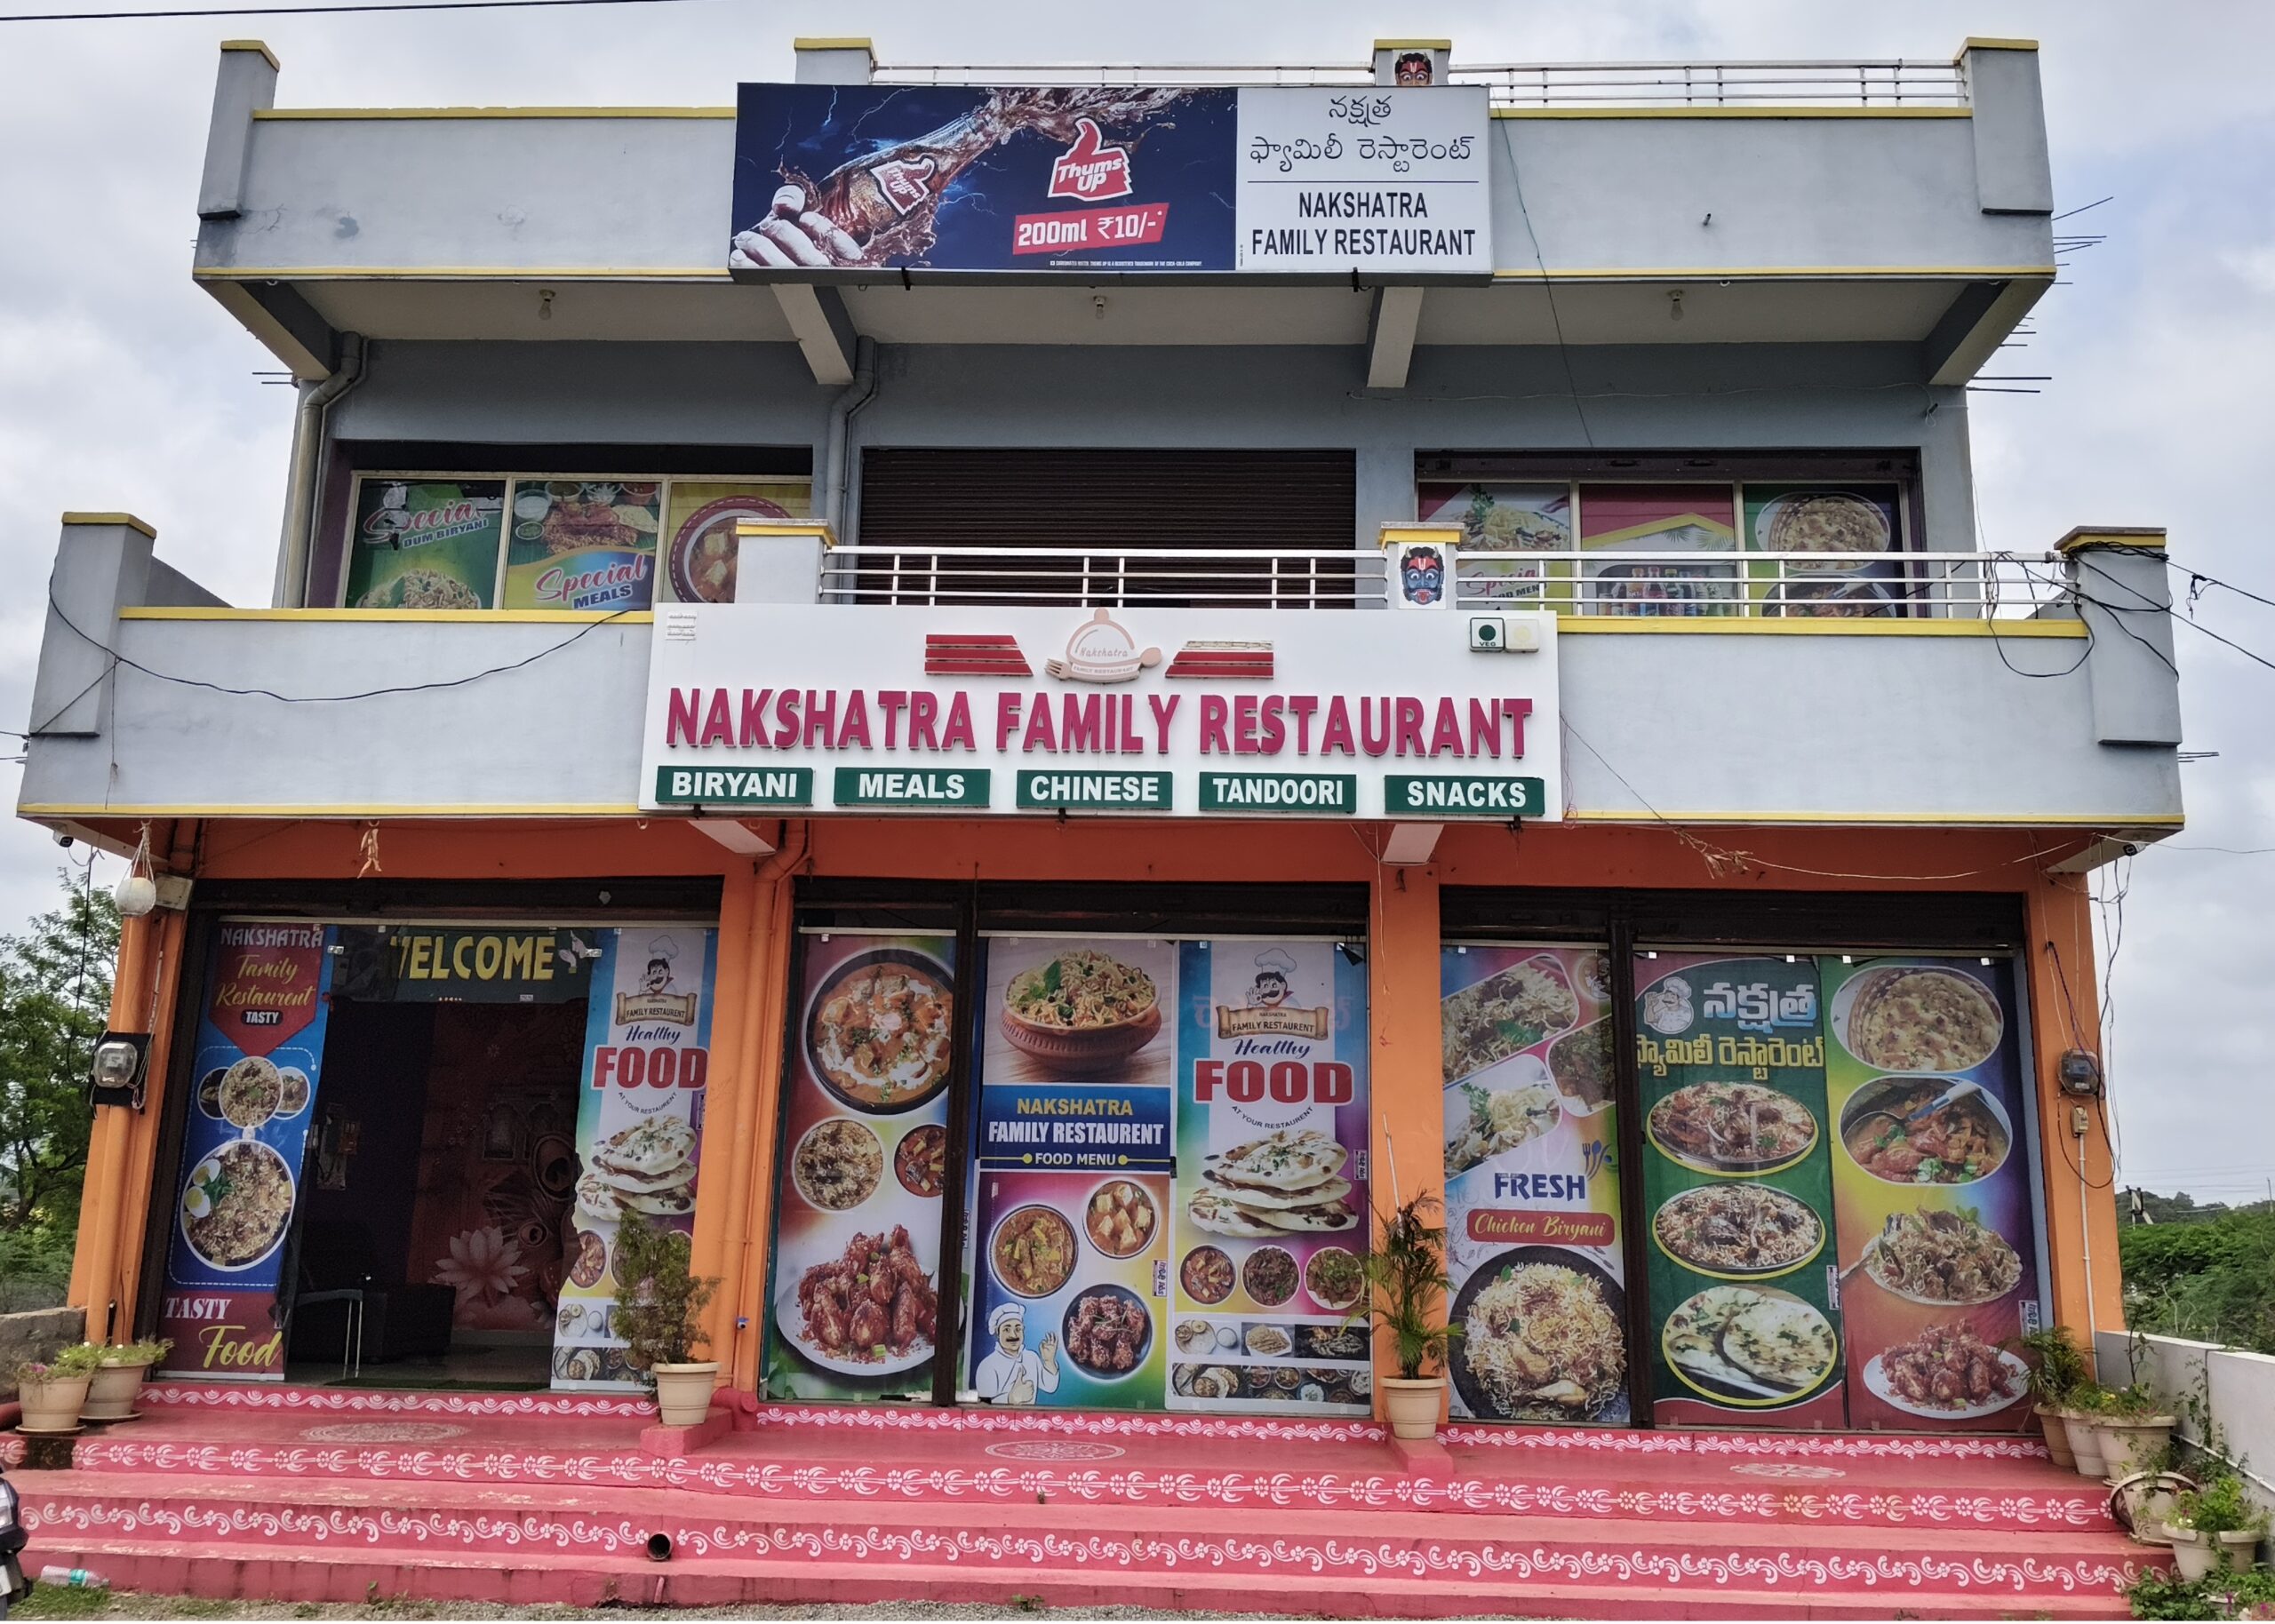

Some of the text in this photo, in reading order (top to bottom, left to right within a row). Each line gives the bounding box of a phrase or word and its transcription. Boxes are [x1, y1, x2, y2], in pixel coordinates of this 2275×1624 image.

[1329, 95, 1392, 128] నక్షత్ర
[1249, 132, 1475, 172] ఫ్యామిలీ రెస్టారెంట్
[1058, 157, 1122, 184] Thums
[1077, 172, 1107, 193] UP
[1298, 192, 1428, 218] NAKSHATRA
[1018, 219, 1088, 247] 200ml
[1251, 228, 1476, 255] FAMILY RESTAURANT
[403, 520, 488, 548] DUM BIRYANI
[535, 554, 644, 602] Special
[573, 585, 633, 609] MEALS
[1079, 647, 1128, 657] Nakshatra
[666, 688, 1533, 760] NAKSHATRA FAMILY RESTAURANT
[671, 771, 798, 798] BIRYANI
[858, 773, 965, 800] MEALS
[1030, 776, 1159, 801] CHINESE
[1212, 778, 1343, 806] TANDOORI
[1407, 781, 1527, 808] SNACKS
[220, 928, 324, 949] NAKSHATRA
[235, 954, 299, 985] Family
[245, 1011, 280, 1024] TASTY
[626, 1009, 648, 1018] FAMILY
[1704, 982, 1817, 1035] నక్షత్ర
[626, 1024, 681, 1046] Healthy
[1232, 1021, 1315, 1033] FAMILY RESTAURENT
[1234, 1038, 1313, 1060] Healthy
[593, 1047, 708, 1089] FOOD
[1194, 1060, 1353, 1104] FOOD
[625, 1100, 640, 1113] YOUR
[1017, 1098, 1134, 1116] NAKSHATRA
[1232, 1105, 1313, 1129] AT YOUR RESTAURENT
[988, 1121, 1164, 1145] FAMILY RESTAURENT
[1034, 1152, 1116, 1166] FOOD MENU
[1494, 1172, 1586, 1202] FRESH
[1474, 1213, 1607, 1241] Chicken Biryani
[164, 1297, 233, 1320] TASTY
[198, 1325, 283, 1369] Food
